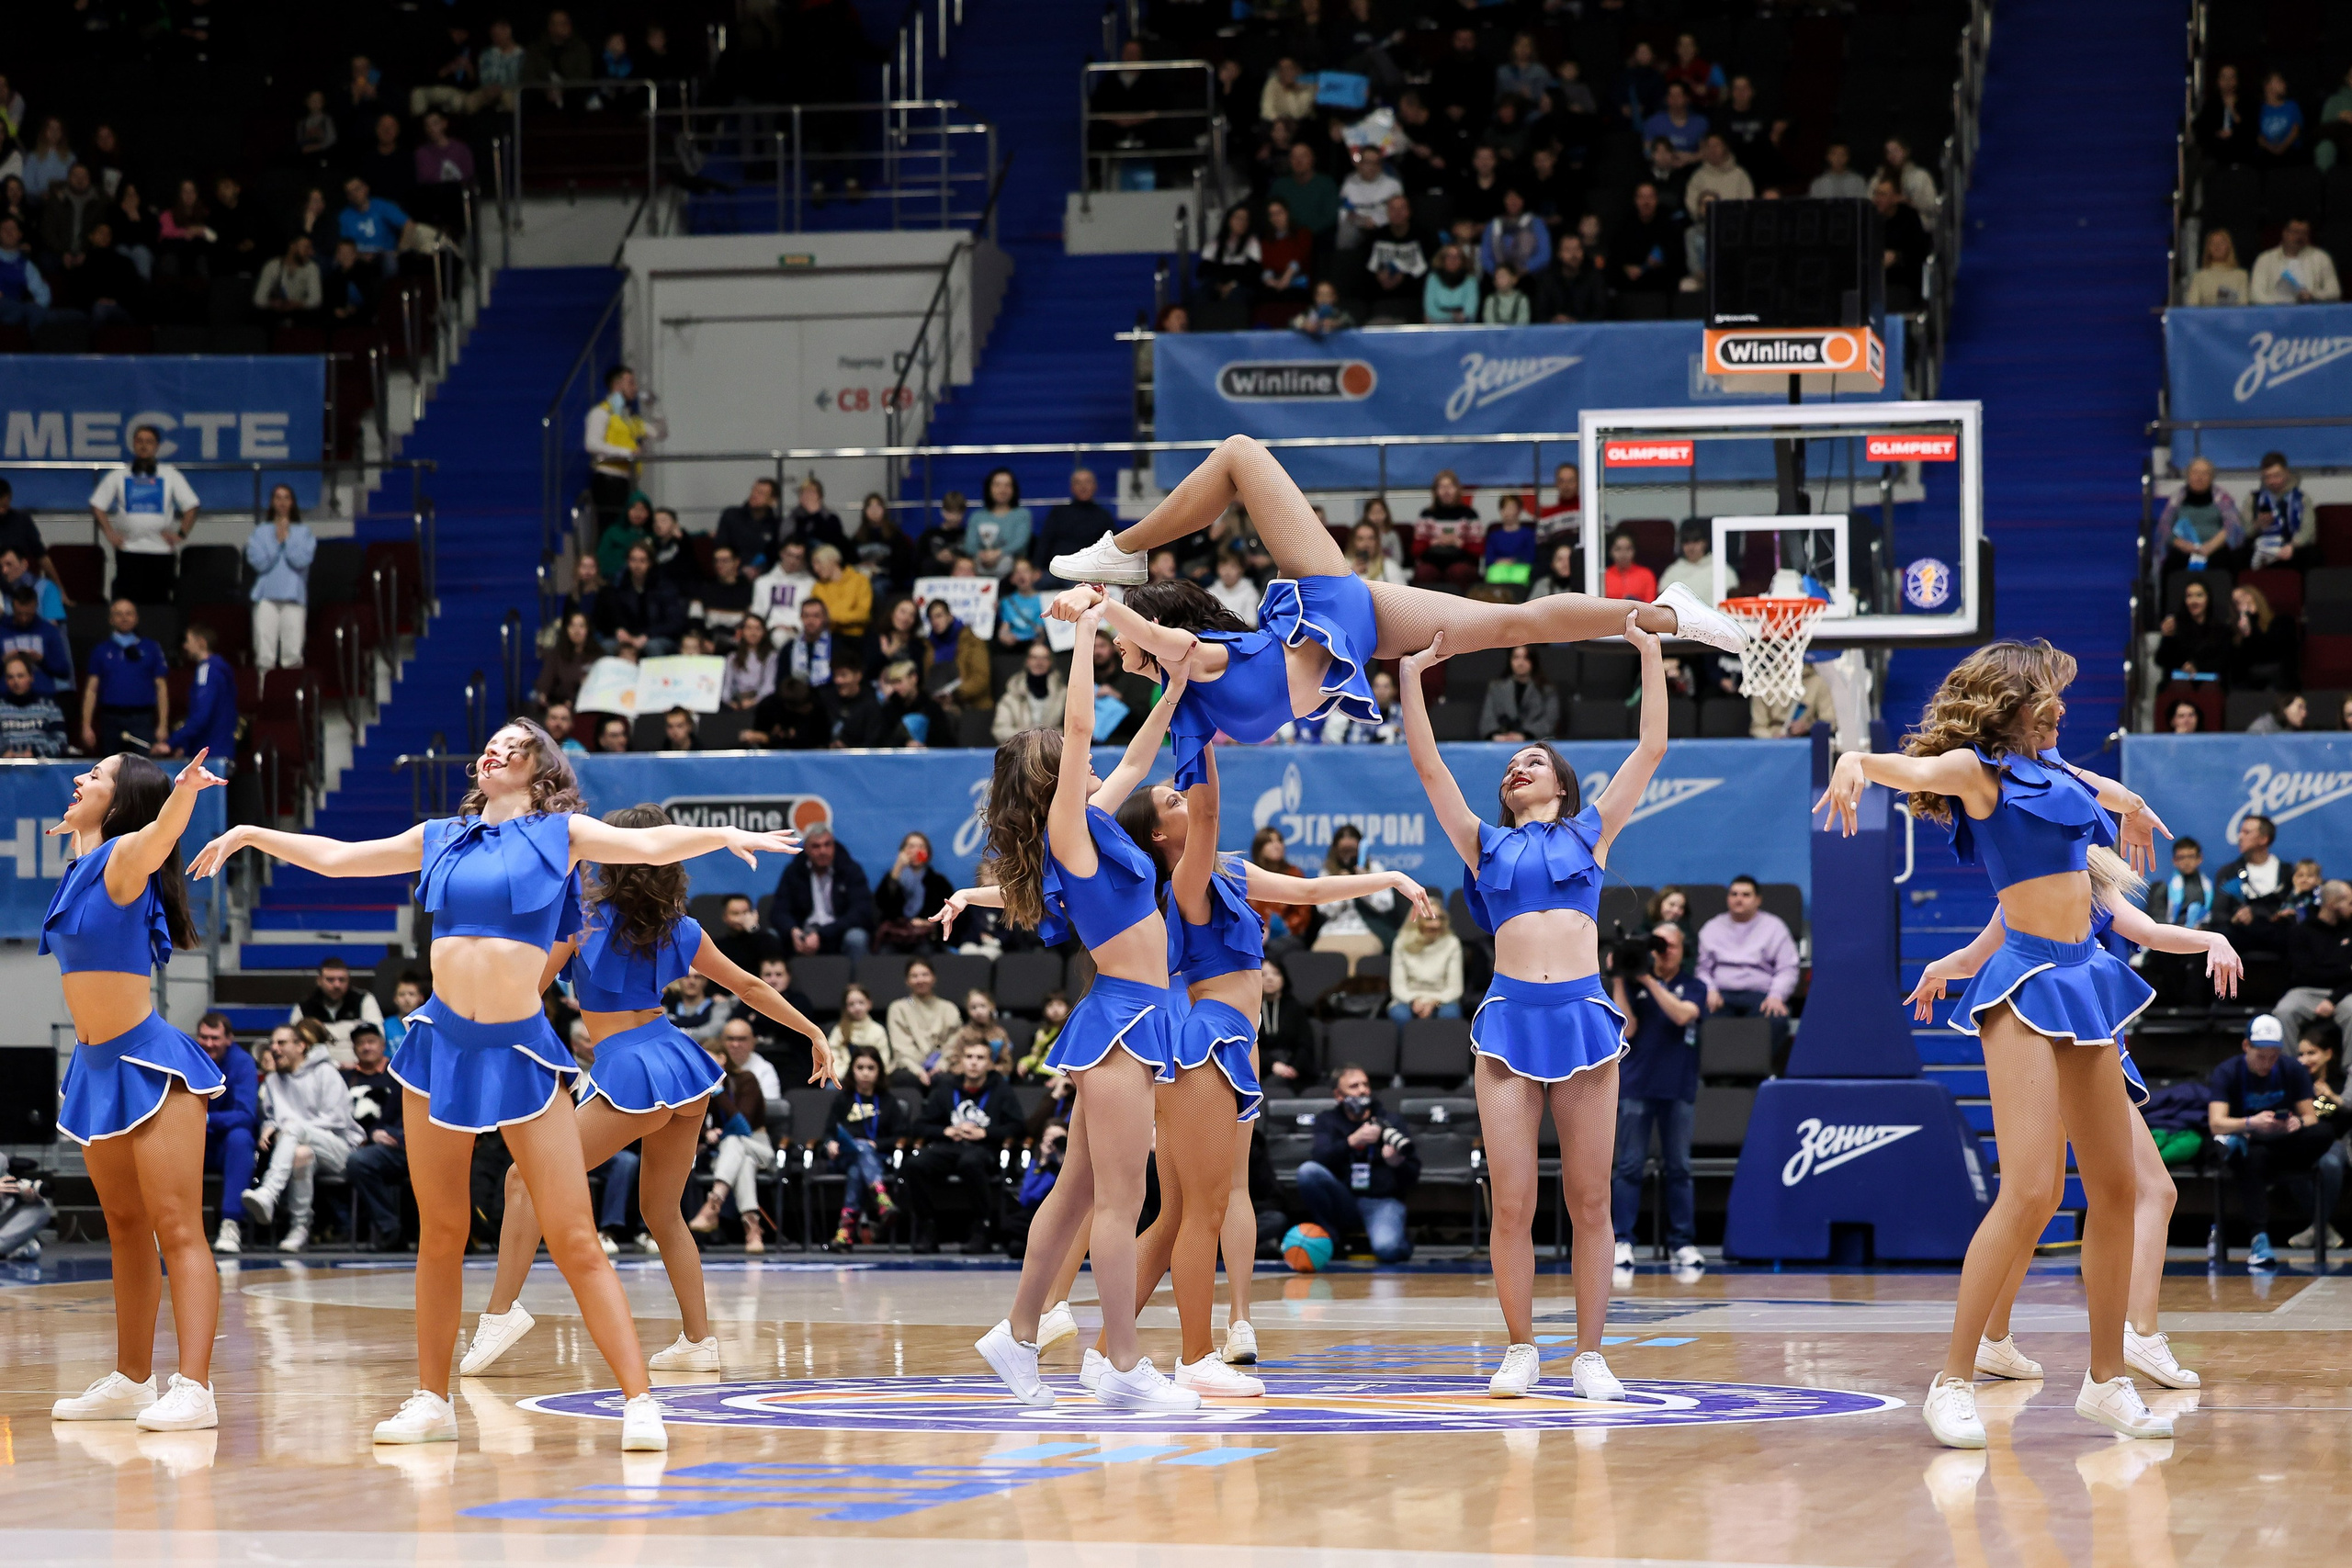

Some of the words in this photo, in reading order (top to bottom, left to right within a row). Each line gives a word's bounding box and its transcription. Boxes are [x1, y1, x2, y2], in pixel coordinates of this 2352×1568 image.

[1727, 340, 1817, 363] Winline
[1231, 370, 1332, 394] Winline
[1607, 446, 1691, 461] OLIMPBET
[1869, 440, 1953, 457] OLIMPBET
[672, 806, 783, 832] Winline
